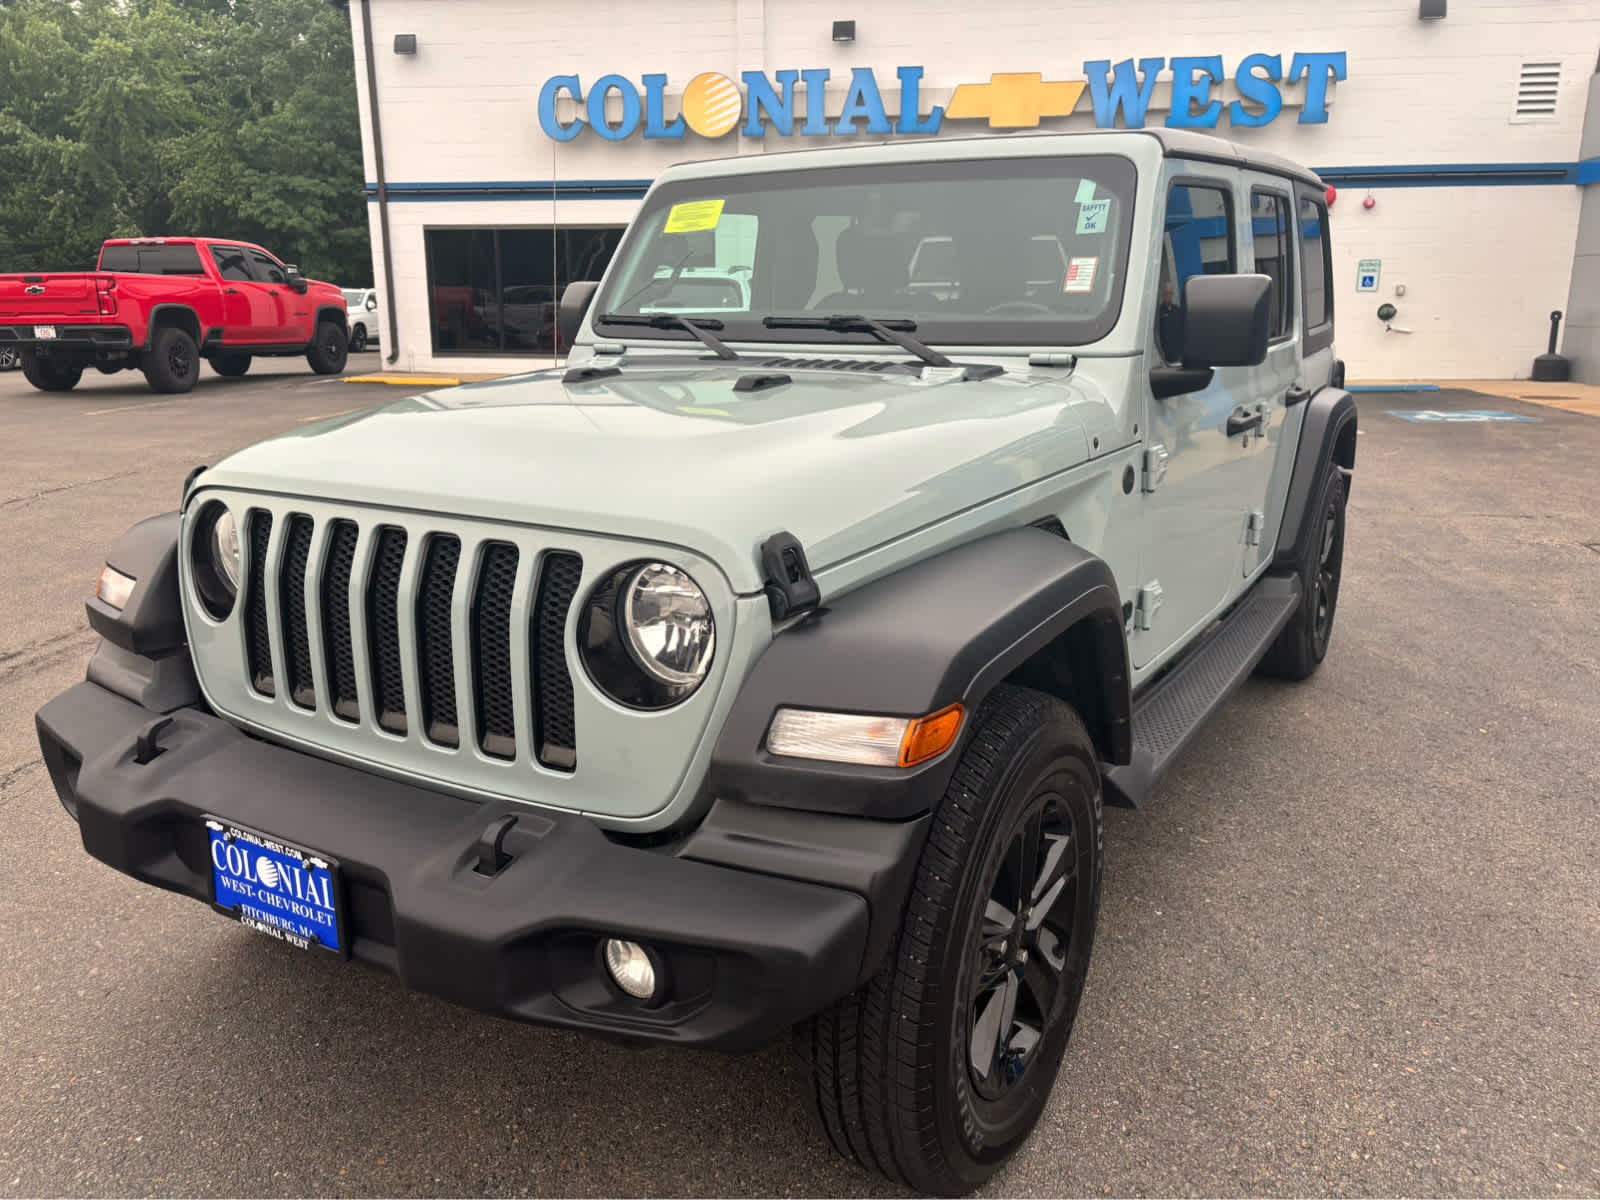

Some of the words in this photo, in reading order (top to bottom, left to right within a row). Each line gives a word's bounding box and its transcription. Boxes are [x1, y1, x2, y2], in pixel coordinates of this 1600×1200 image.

[538, 65, 944, 143] COLONIAL
[1083, 51, 1347, 129] WEST
[1084, 222, 1097, 230] OK
[211, 839, 335, 911] COLONIAL
[258, 889, 333, 927] CHEVROLET
[240, 915, 284, 940] COLONIAL
[285, 932, 309, 950] WEST
